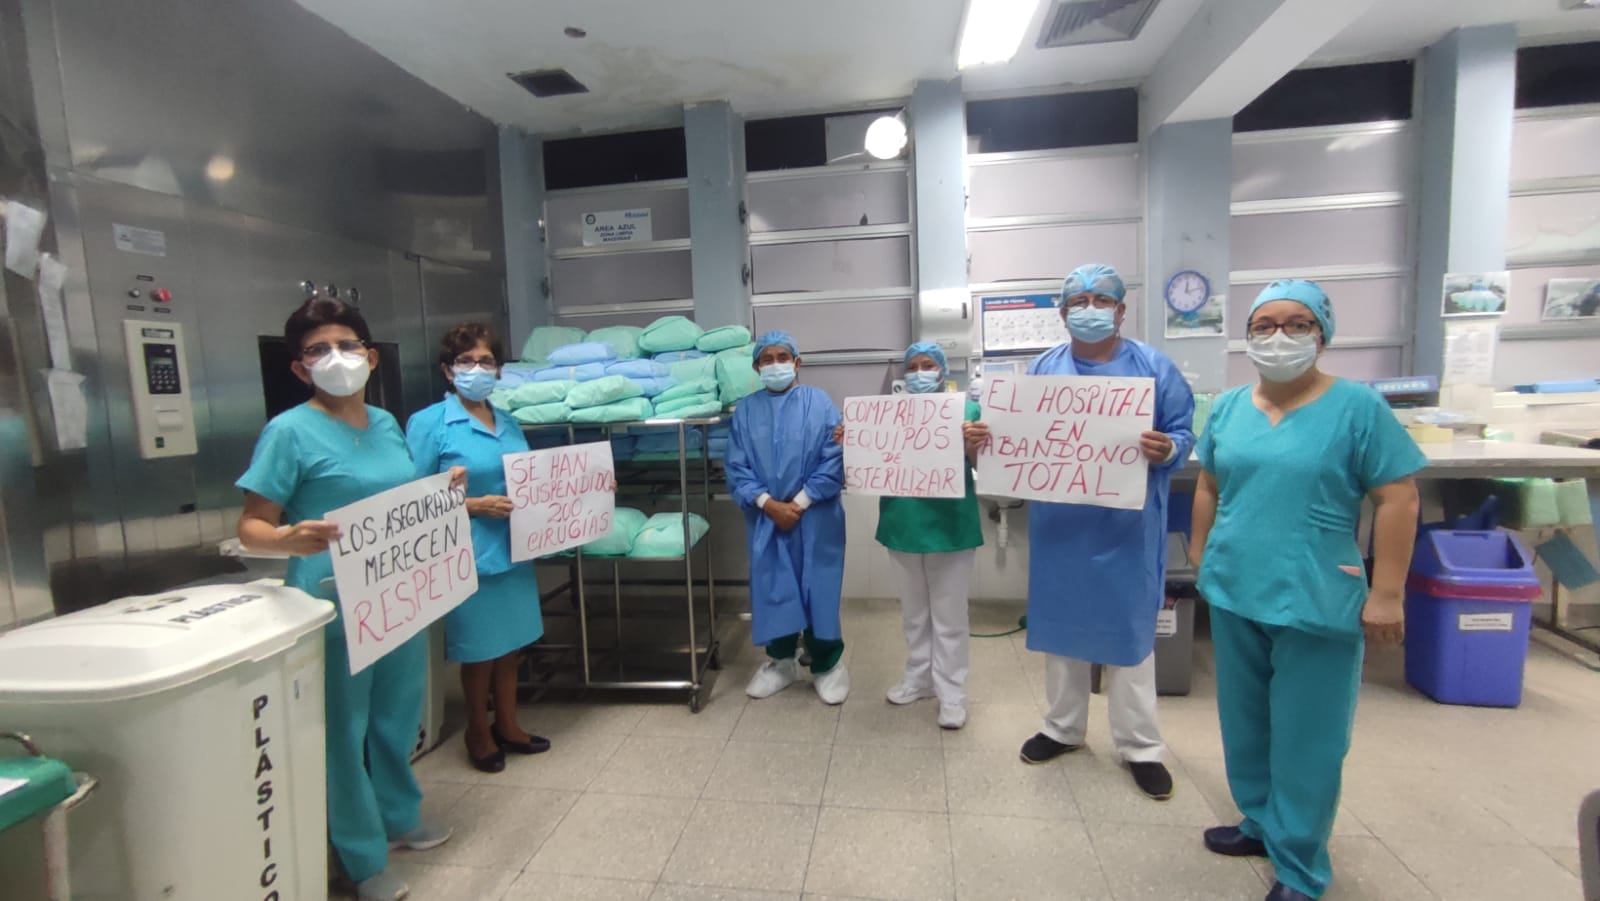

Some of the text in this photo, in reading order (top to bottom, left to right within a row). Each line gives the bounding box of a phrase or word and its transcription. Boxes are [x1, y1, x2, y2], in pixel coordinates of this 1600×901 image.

[617, 223, 637, 231] AZUL
[845, 398, 955, 427] COMPRA DE
[987, 379, 1151, 417] EL HOSPITAL
[845, 425, 950, 451] EQUIPOS
[1045, 419, 1087, 442] EN
[881, 451, 903, 464] DE
[980, 433, 1140, 465] ABANDONO
[510, 451, 588, 485] SE HAN
[845, 466, 957, 496] ESTERILIZAR
[1004, 461, 1120, 497] TOTAL
[546, 498, 583, 523] 200
[338, 516, 378, 557] LOS
[365, 516, 459, 586] MERECEN
[354, 548, 471, 645] RESPETO
